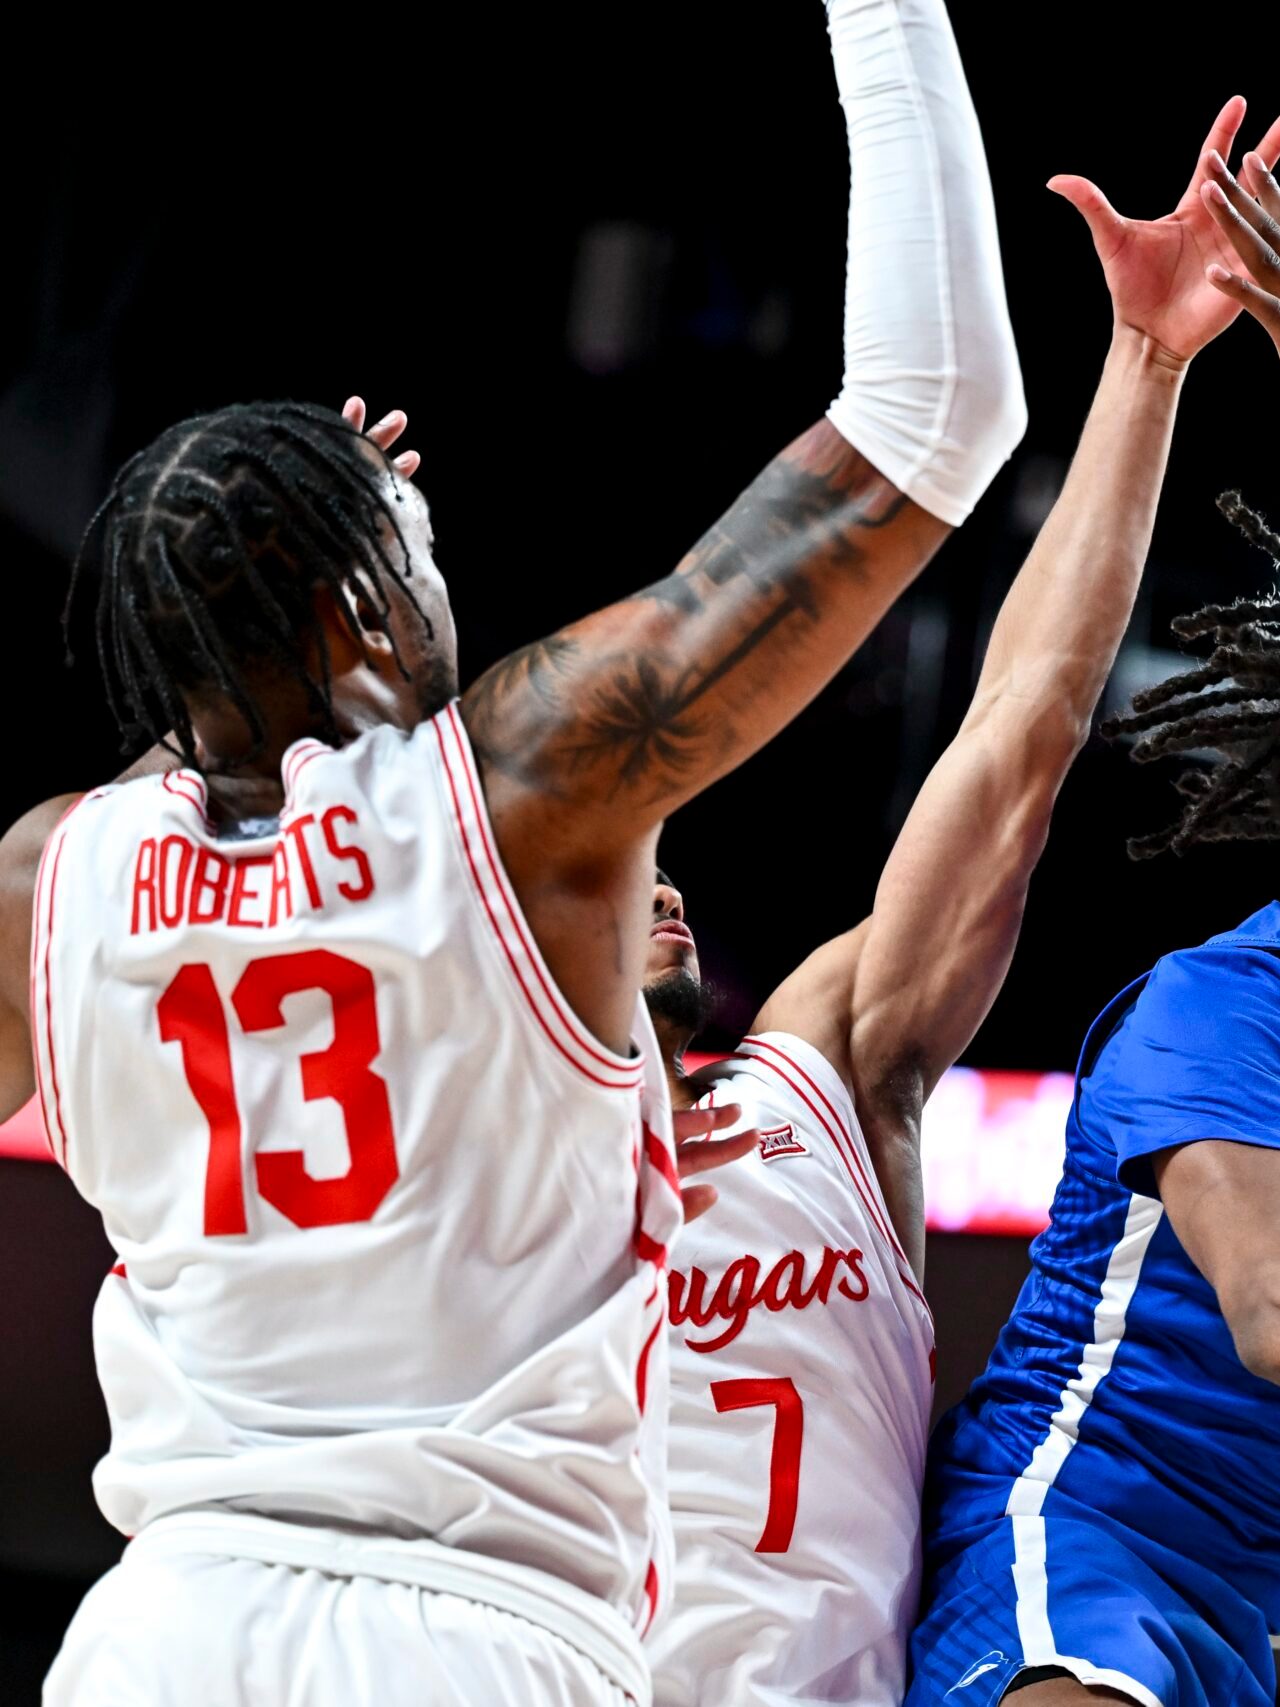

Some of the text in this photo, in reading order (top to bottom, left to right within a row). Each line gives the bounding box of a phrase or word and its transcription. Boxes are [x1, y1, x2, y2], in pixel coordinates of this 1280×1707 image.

[130, 804, 375, 935] ROBERTS
[155, 947, 401, 1239] 13
[668, 1245, 870, 1354] ugars
[709, 1376, 804, 1554] 7
